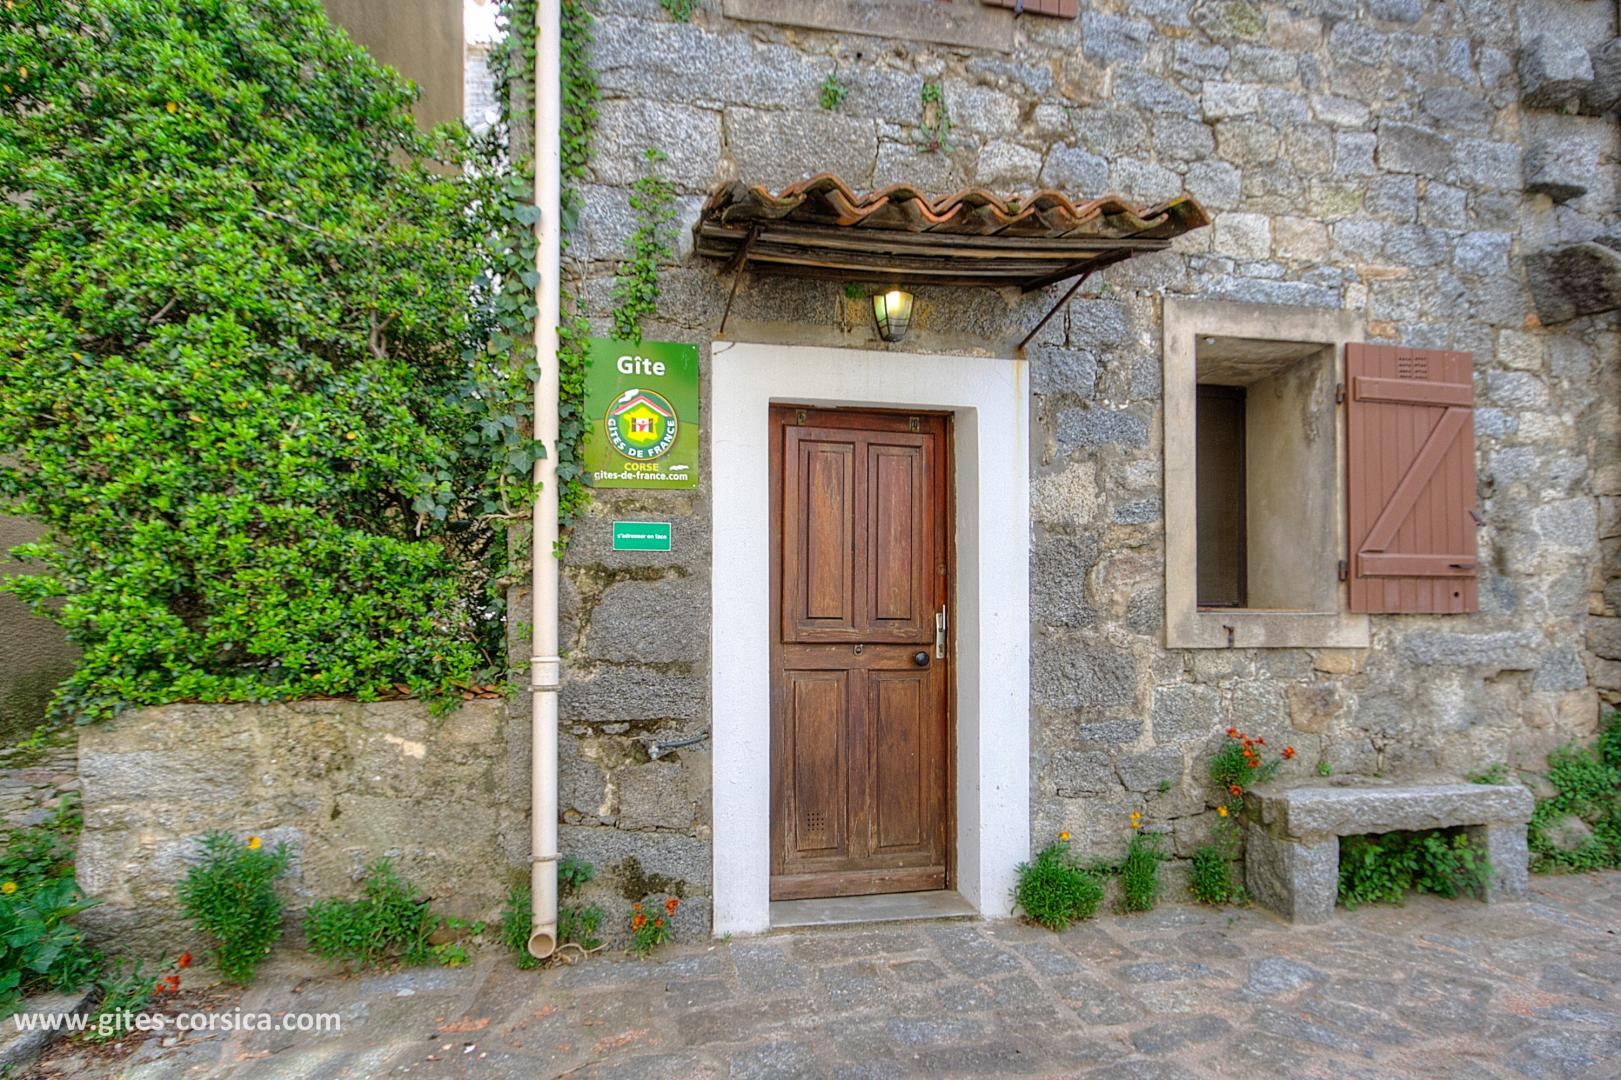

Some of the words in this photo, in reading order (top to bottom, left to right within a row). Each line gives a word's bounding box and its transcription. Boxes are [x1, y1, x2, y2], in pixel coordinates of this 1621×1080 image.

[616, 355, 666, 376] Gîte
[628, 448, 644, 458] DE
[648, 419, 675, 457] FRANCE
[624, 463, 659, 472] CORSE
[594, 471, 688, 481] gites-de-france.com
